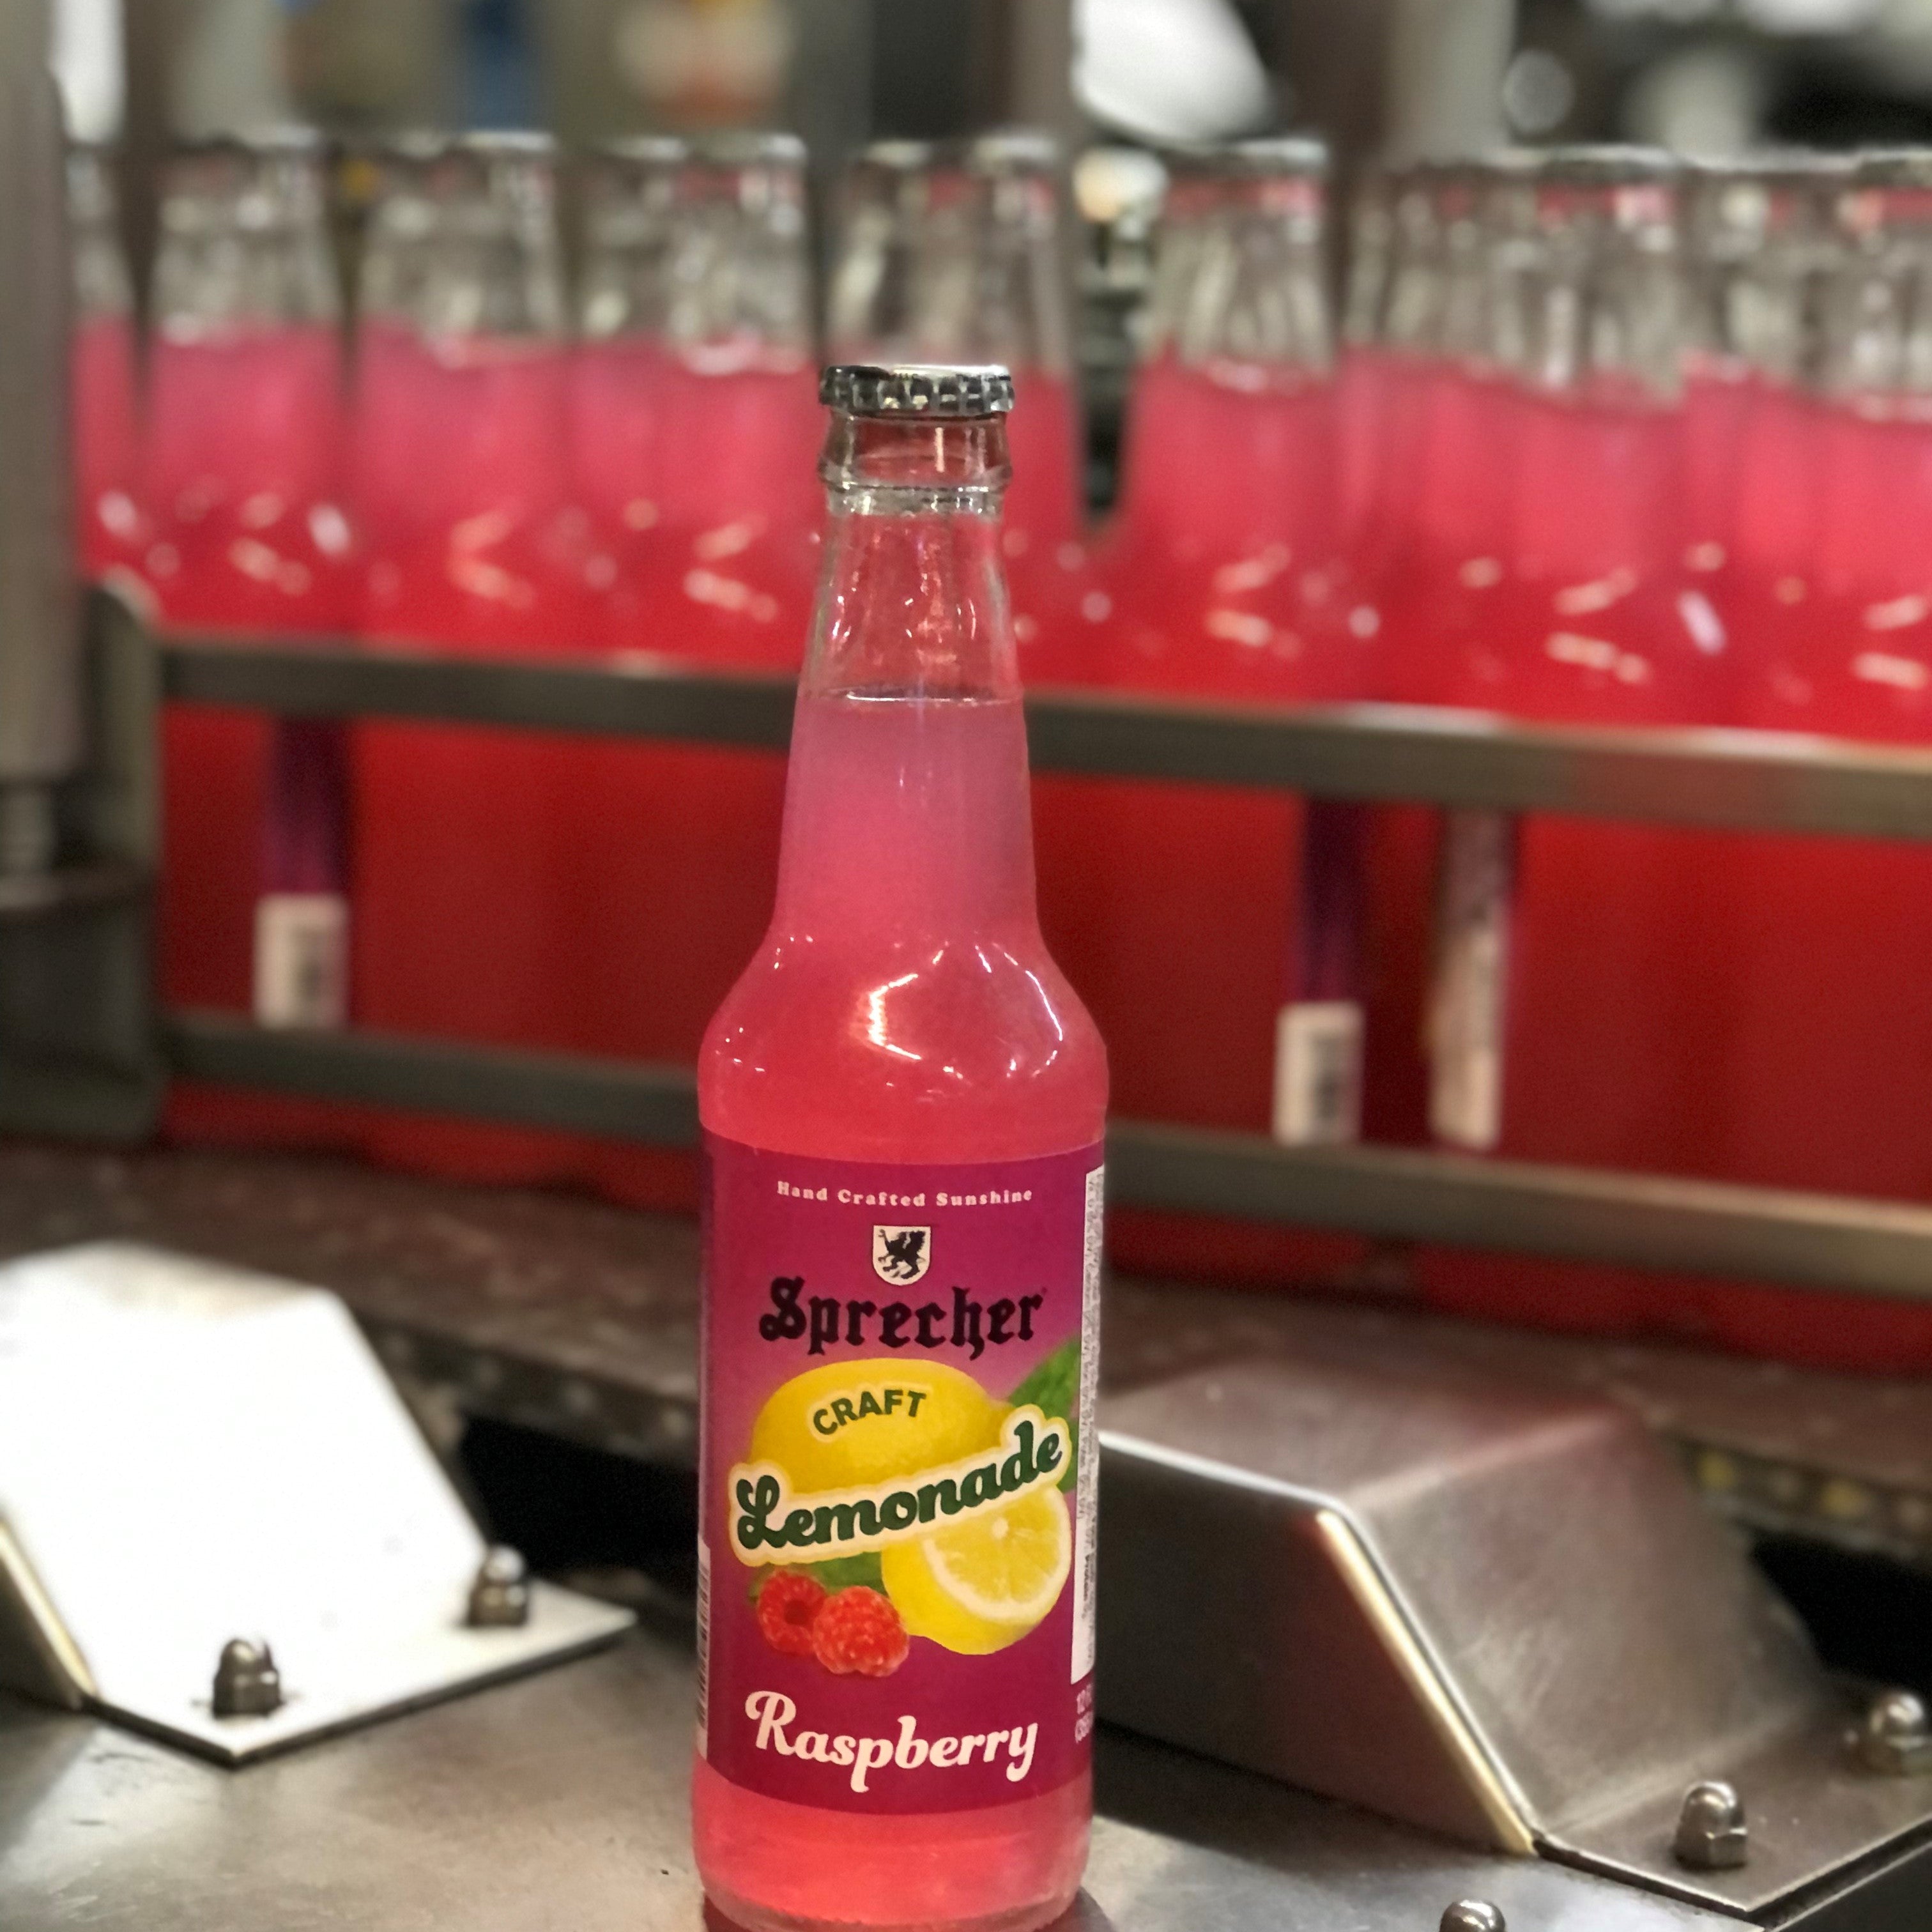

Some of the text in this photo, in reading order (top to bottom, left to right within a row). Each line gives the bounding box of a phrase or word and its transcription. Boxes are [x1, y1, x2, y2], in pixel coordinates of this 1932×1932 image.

[777, 1180, 1033, 1207] Hand Crafted Sunshine
[759, 1276, 1044, 1361] Sprecher
[813, 1388, 927, 1436] CRAFT
[735, 1420, 1062, 1550] Lemonade
[744, 1690, 1039, 1793] Raspberry
